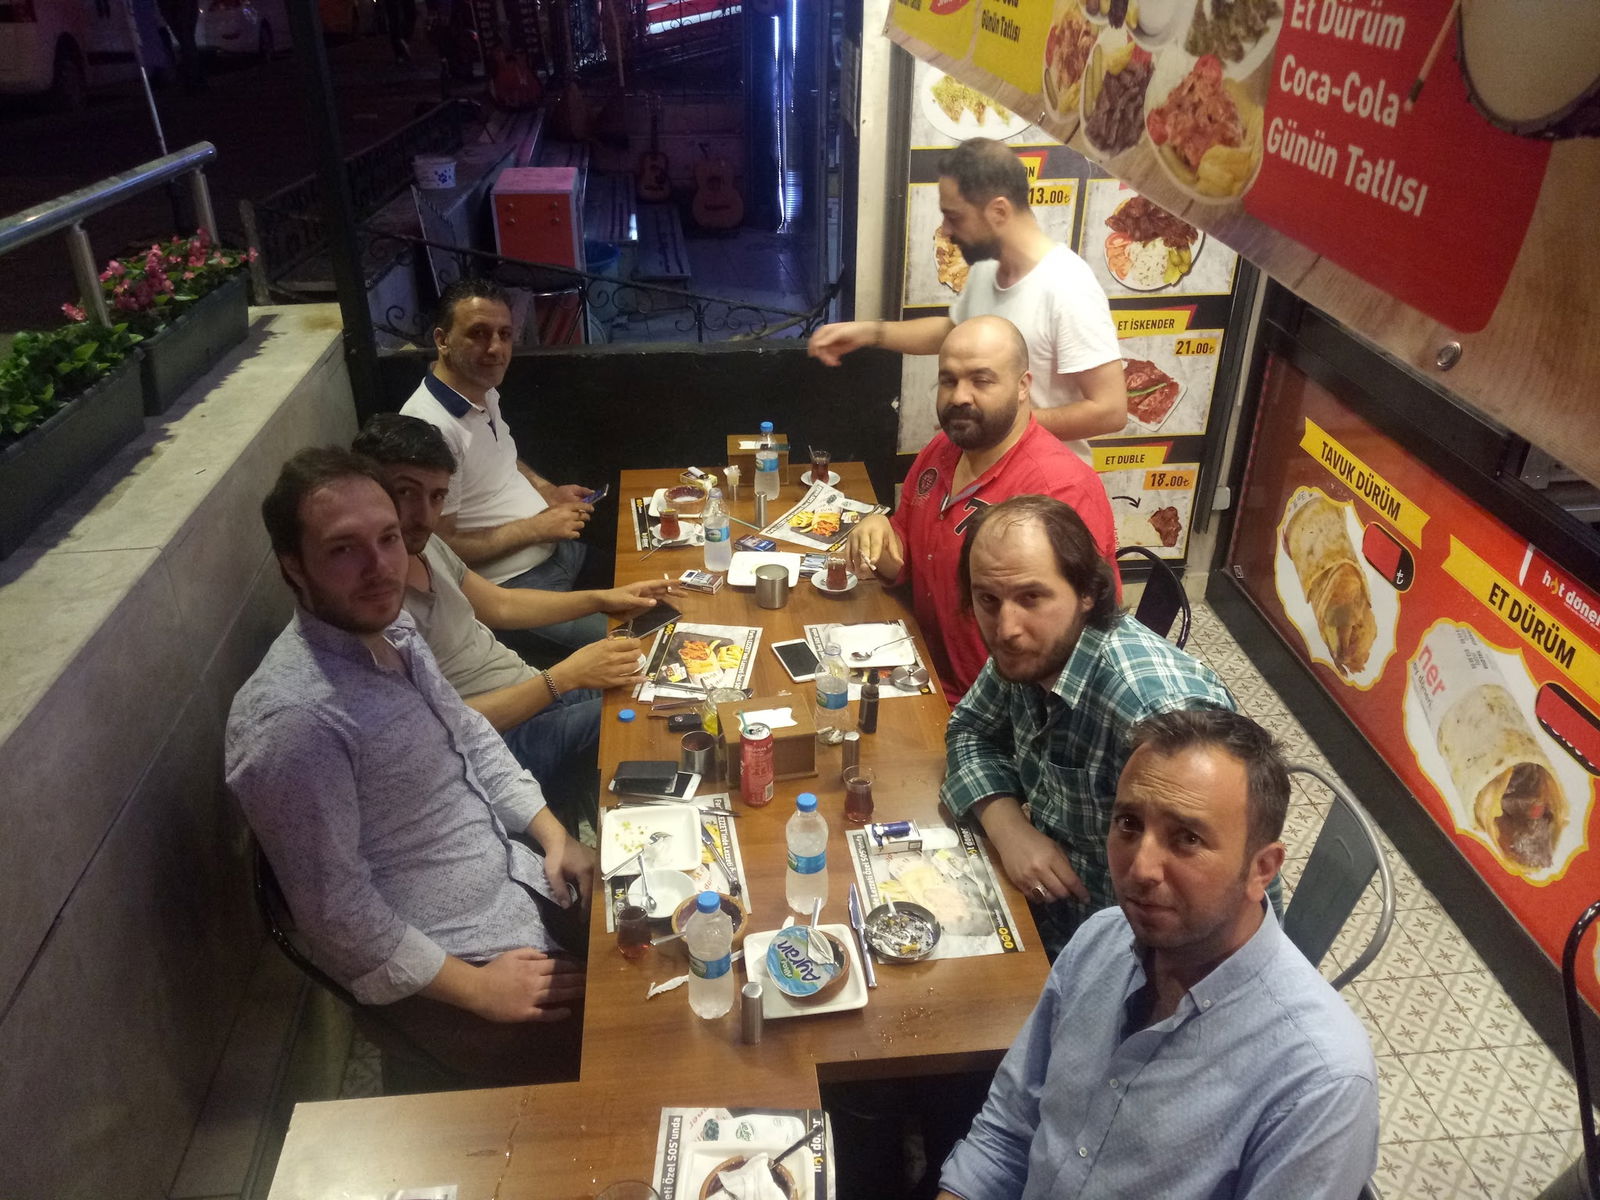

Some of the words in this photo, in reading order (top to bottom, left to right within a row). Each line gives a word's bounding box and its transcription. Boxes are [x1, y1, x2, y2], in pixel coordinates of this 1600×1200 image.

[1000, 15, 1021, 43] Tatlısı
[1290, 0, 1317, 32] Et
[1317, 0, 1406, 51] Dürüm
[1280, 53, 1400, 128] Coca-Cola
[1266, 116, 1339, 179] Günün
[1344, 143, 1429, 217] Tatlısı
[1117, 320, 1129, 331] ET
[1130, 318, 1175, 331] İSKENDER
[1105, 455, 1116, 465] ET
[1117, 454, 1146, 465] DUBLE
[1321, 440, 1356, 485] TAVUK
[1355, 470, 1402, 522] DÜRÜM
[1488, 582, 1510, 612] ET
[1507, 598, 1577, 670] DÜRÜM
[777, 940, 821, 981] Ayran
[667, 1117, 681, 1162] SOS'unda
[662, 1163, 676, 1184] Özel
